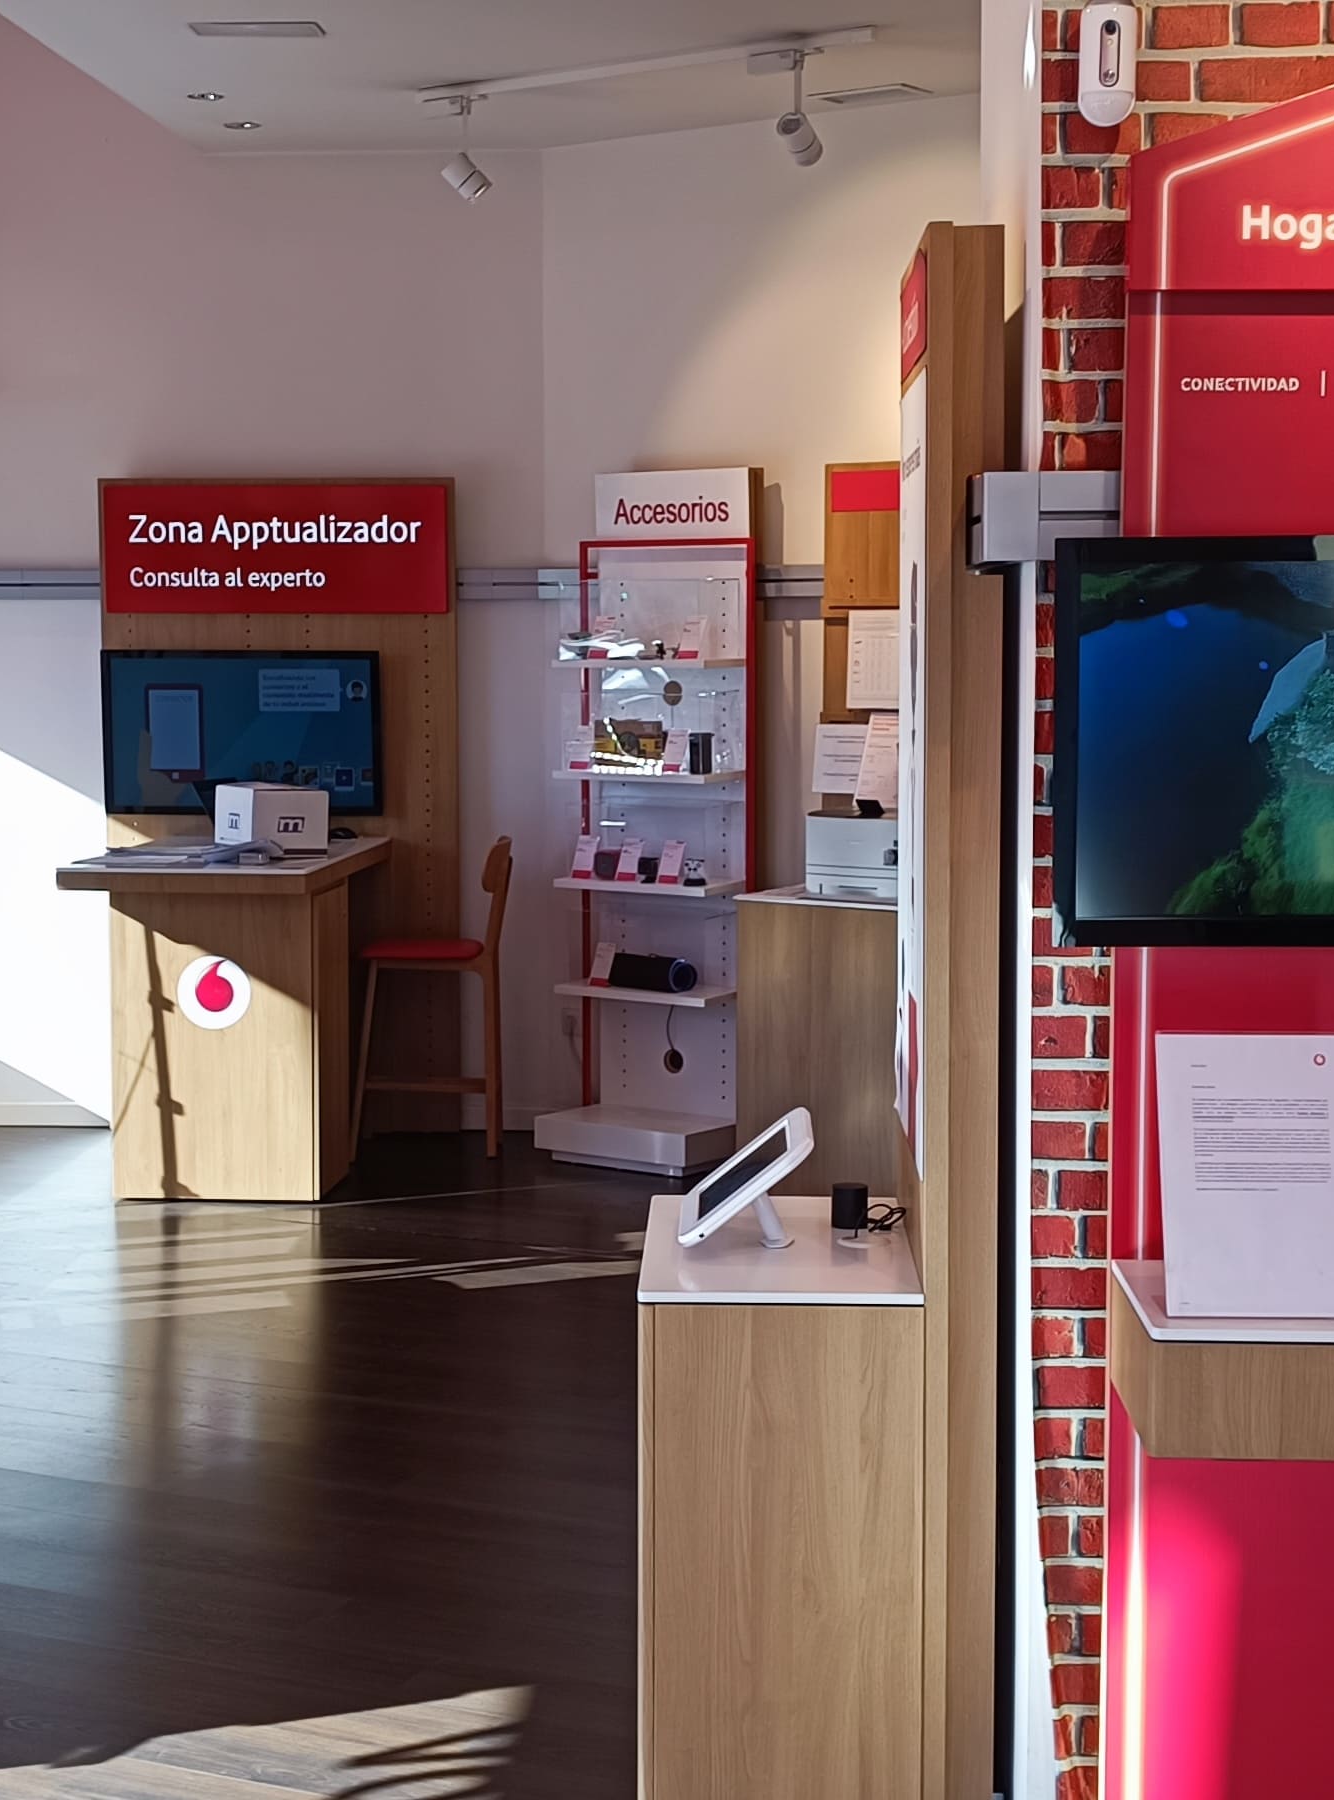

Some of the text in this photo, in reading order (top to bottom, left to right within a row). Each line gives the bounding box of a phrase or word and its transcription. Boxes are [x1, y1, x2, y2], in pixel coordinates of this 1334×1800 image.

[1180, 377, 1300, 392] CONECTIVIDAD
[613, 495, 729, 525] Accesorios
[128, 513, 422, 551] Zona Apptualizador
[129, 566, 326, 592] Consulta al experto
